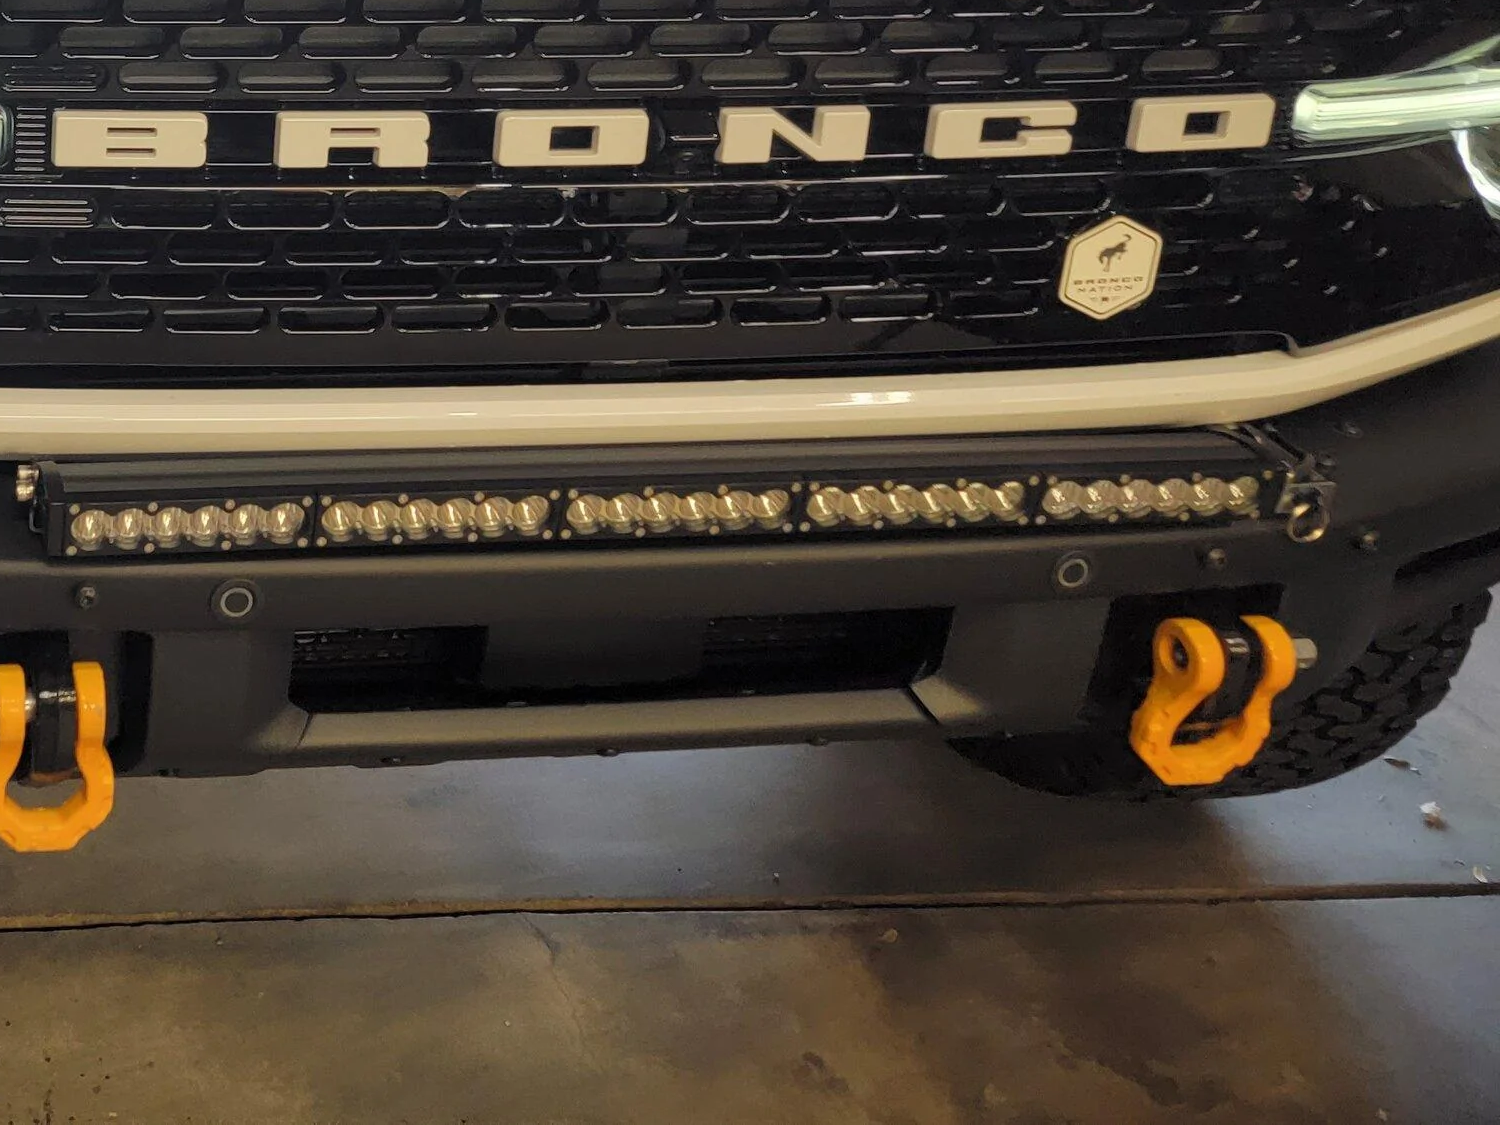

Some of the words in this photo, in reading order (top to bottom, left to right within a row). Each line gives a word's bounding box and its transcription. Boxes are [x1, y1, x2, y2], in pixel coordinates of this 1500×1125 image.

[51, 93, 1276, 169] BRONCO
[1073, 276, 1143, 286] BRONCO
[1077, 285, 1133, 293] NATION
